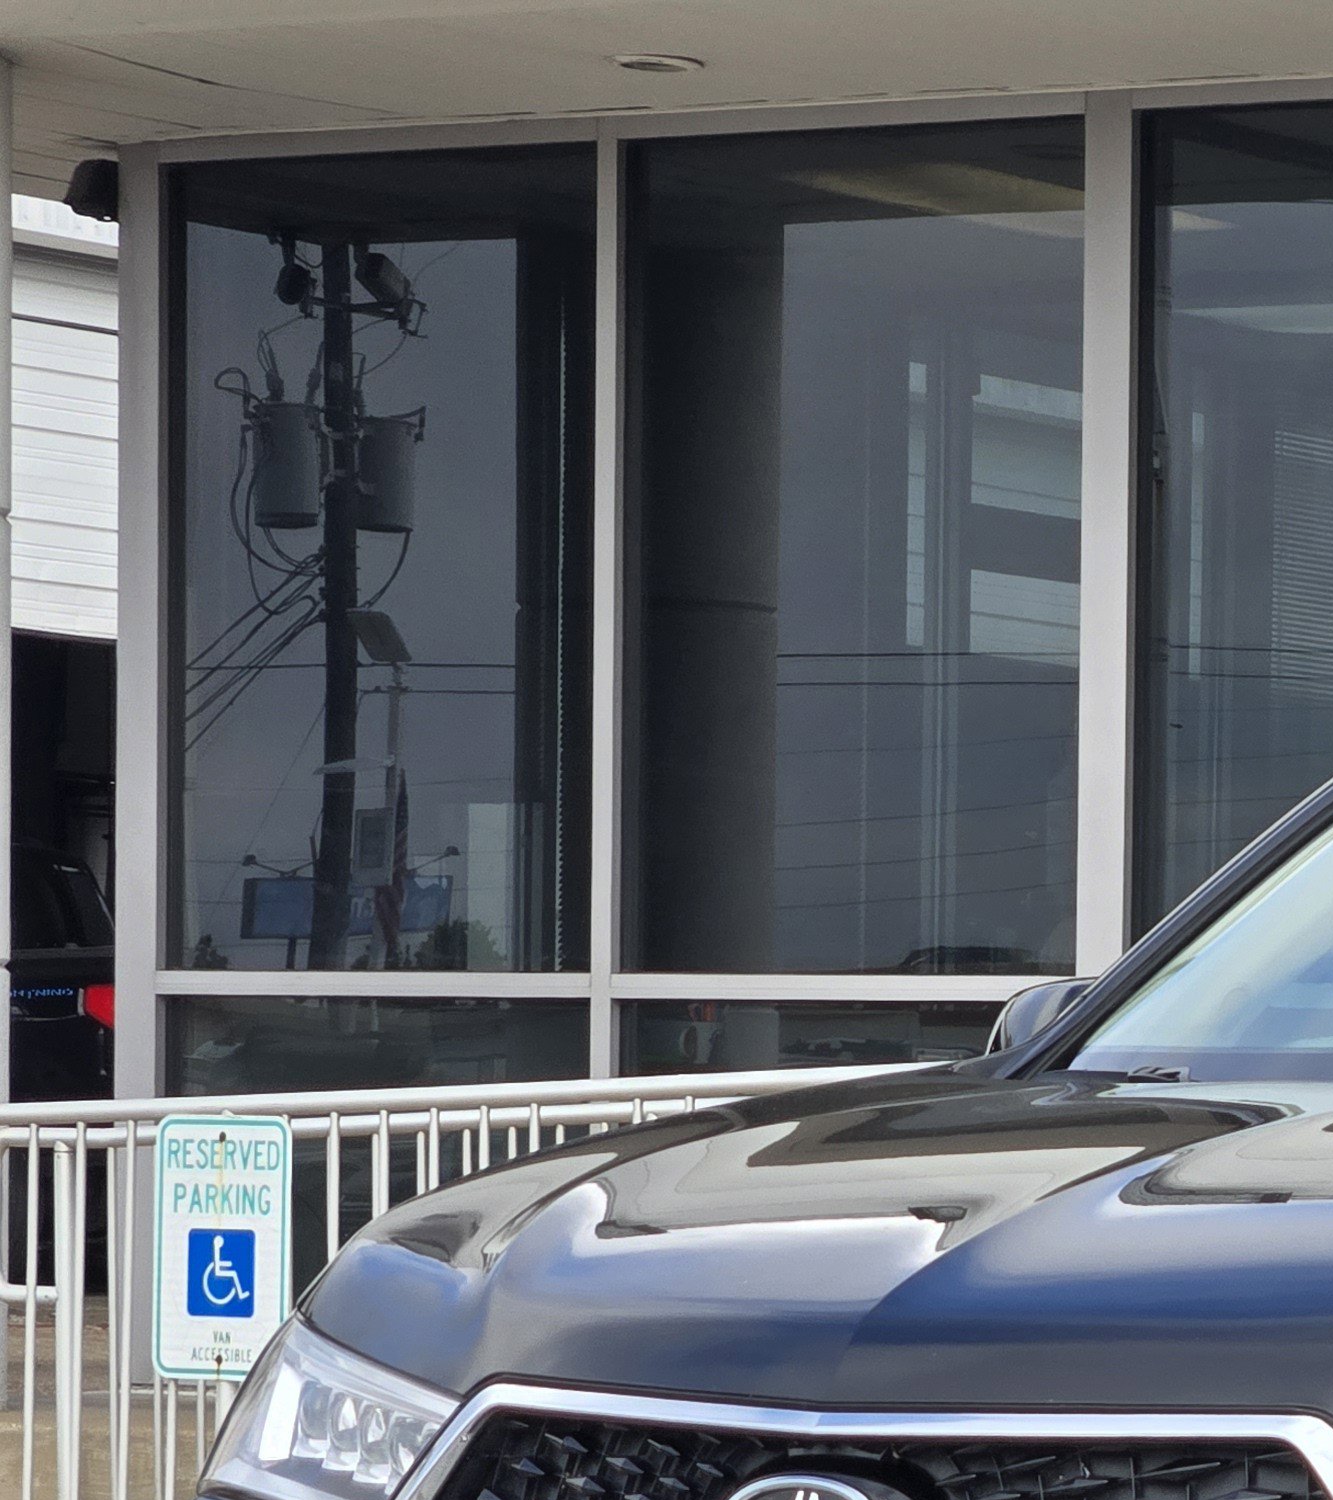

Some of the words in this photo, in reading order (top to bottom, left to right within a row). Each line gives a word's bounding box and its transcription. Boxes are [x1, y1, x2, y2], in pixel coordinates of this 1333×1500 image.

[167, 1138, 280, 1171] RESERVED
[173, 1183, 271, 1215] PARKING
[212, 1330, 231, 1344] VAN
